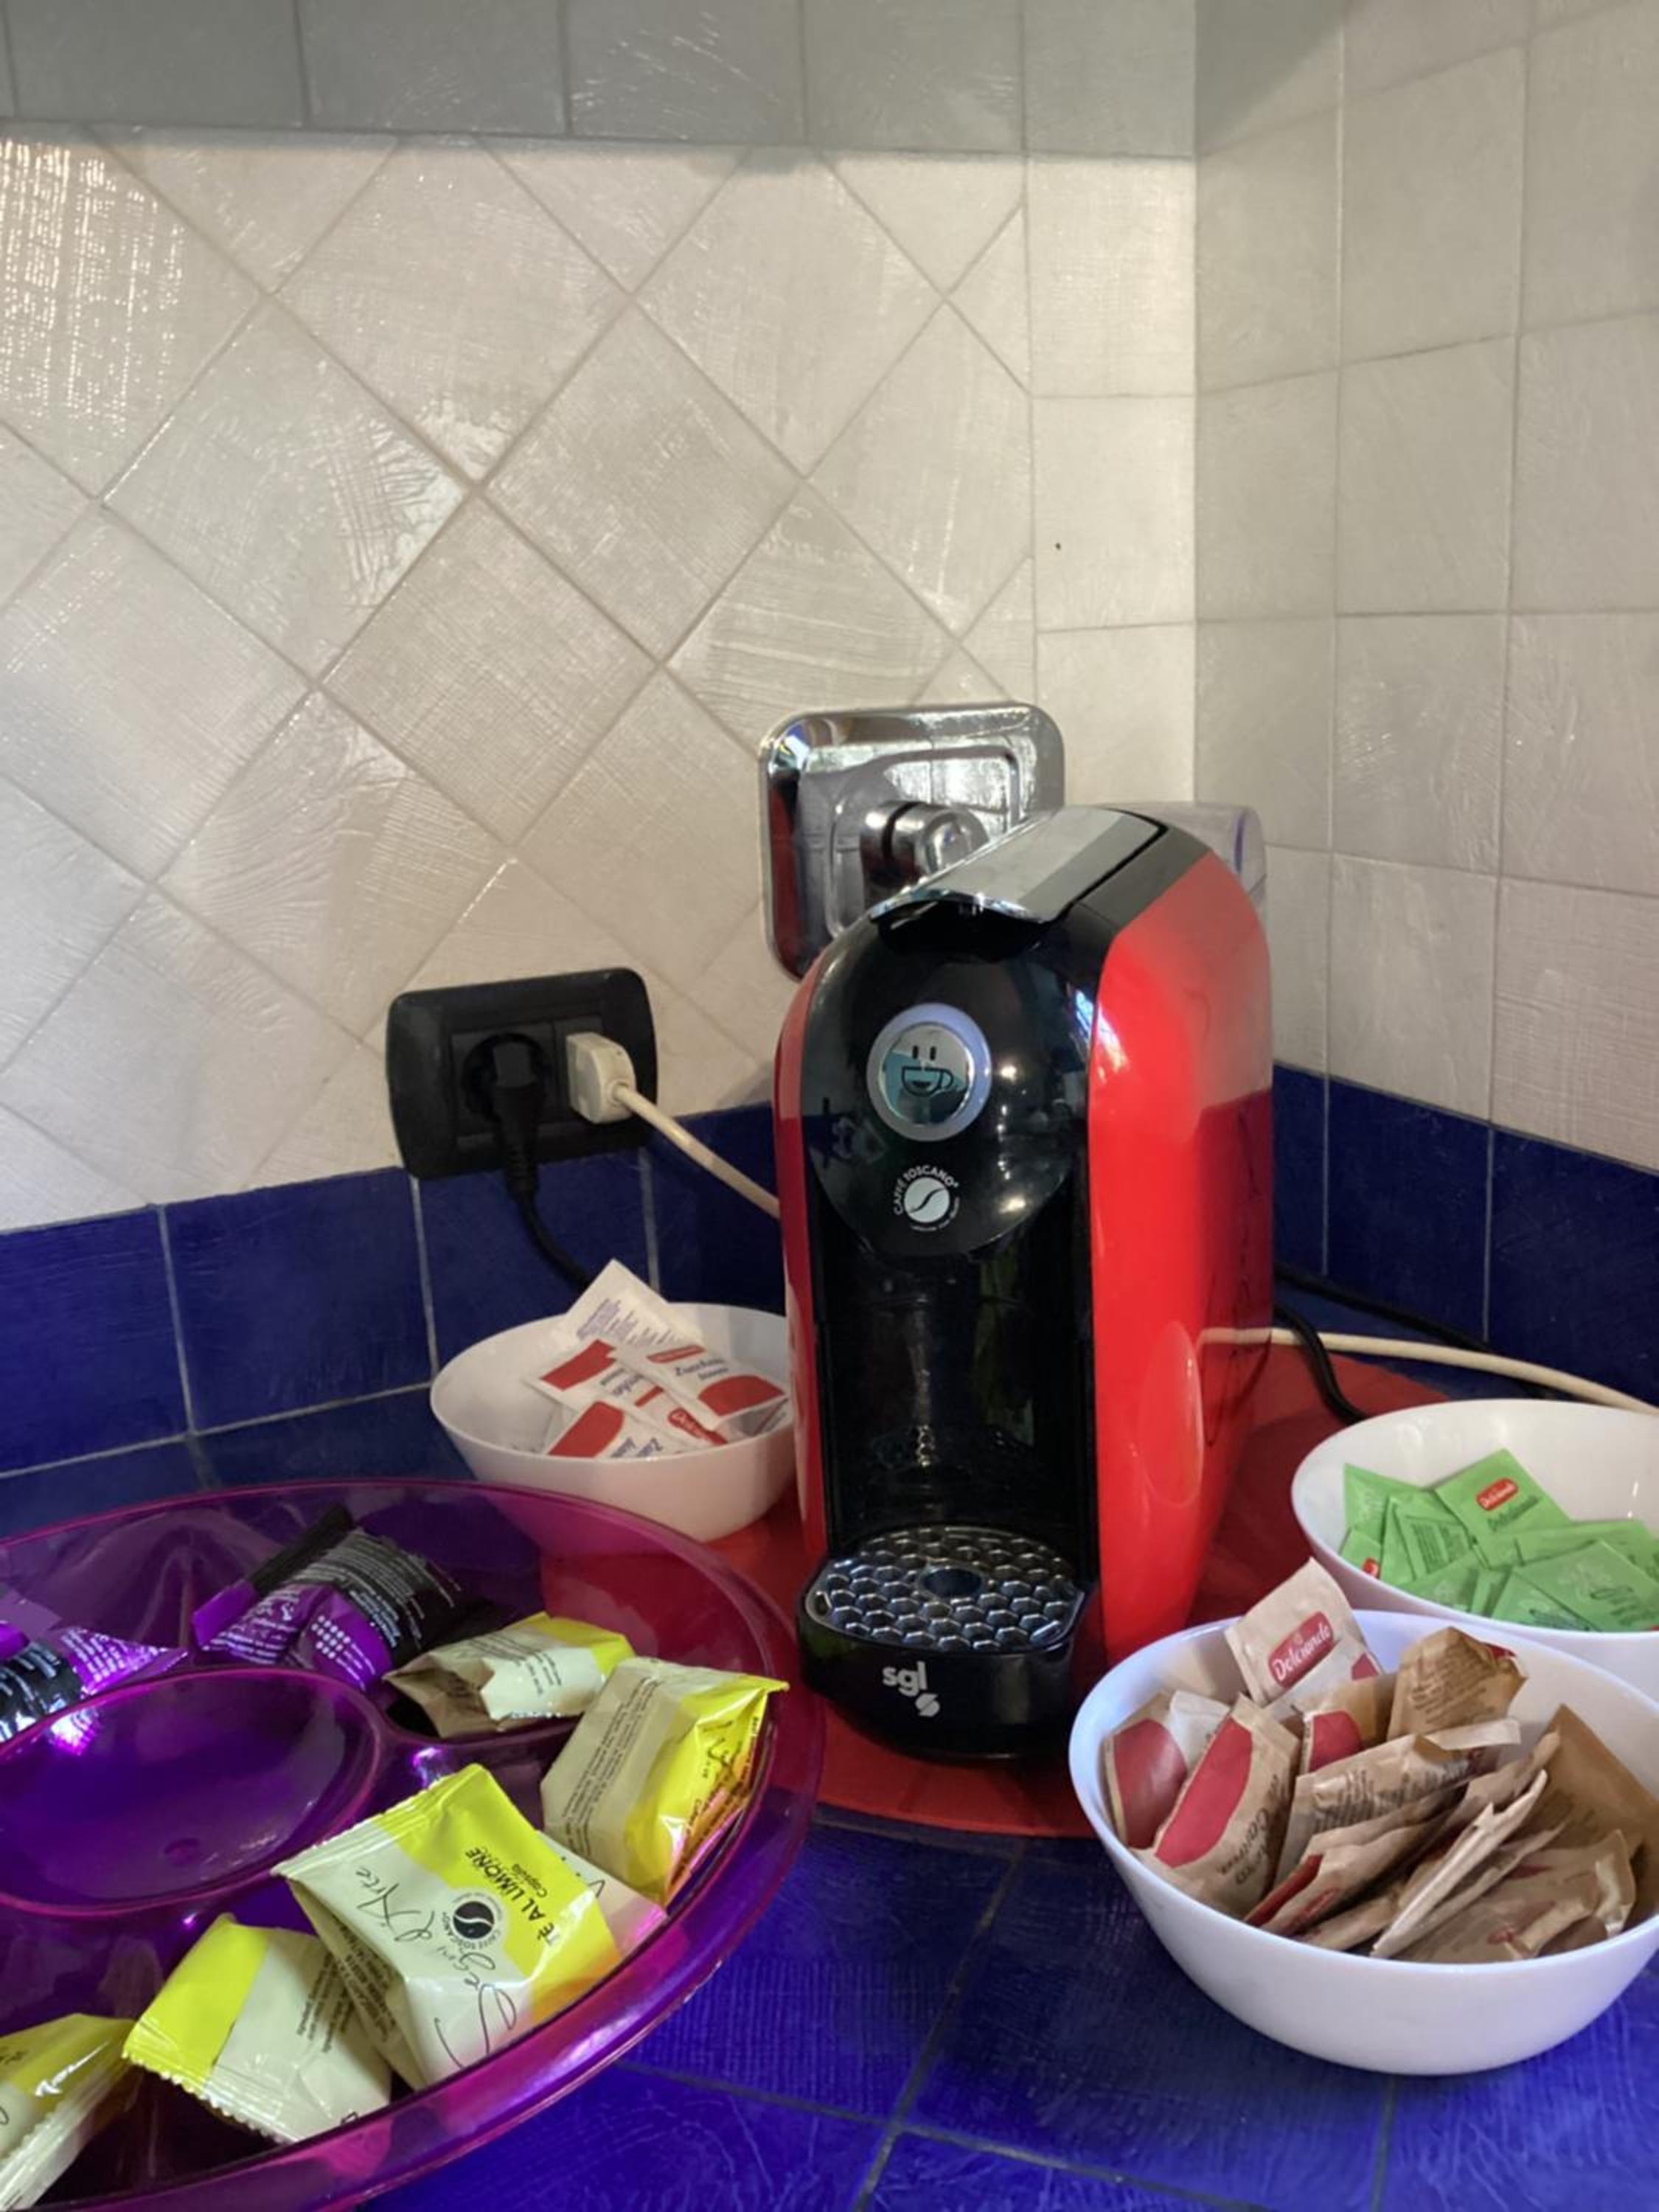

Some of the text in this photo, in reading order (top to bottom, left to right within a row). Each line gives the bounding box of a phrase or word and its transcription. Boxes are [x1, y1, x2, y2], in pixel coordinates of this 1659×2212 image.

[883, 1661, 928, 1697] sgl
[465, 1848, 525, 1902] LIMONE
[511, 1863, 548, 1898] Capsula
[521, 1898, 546, 1921] AL
